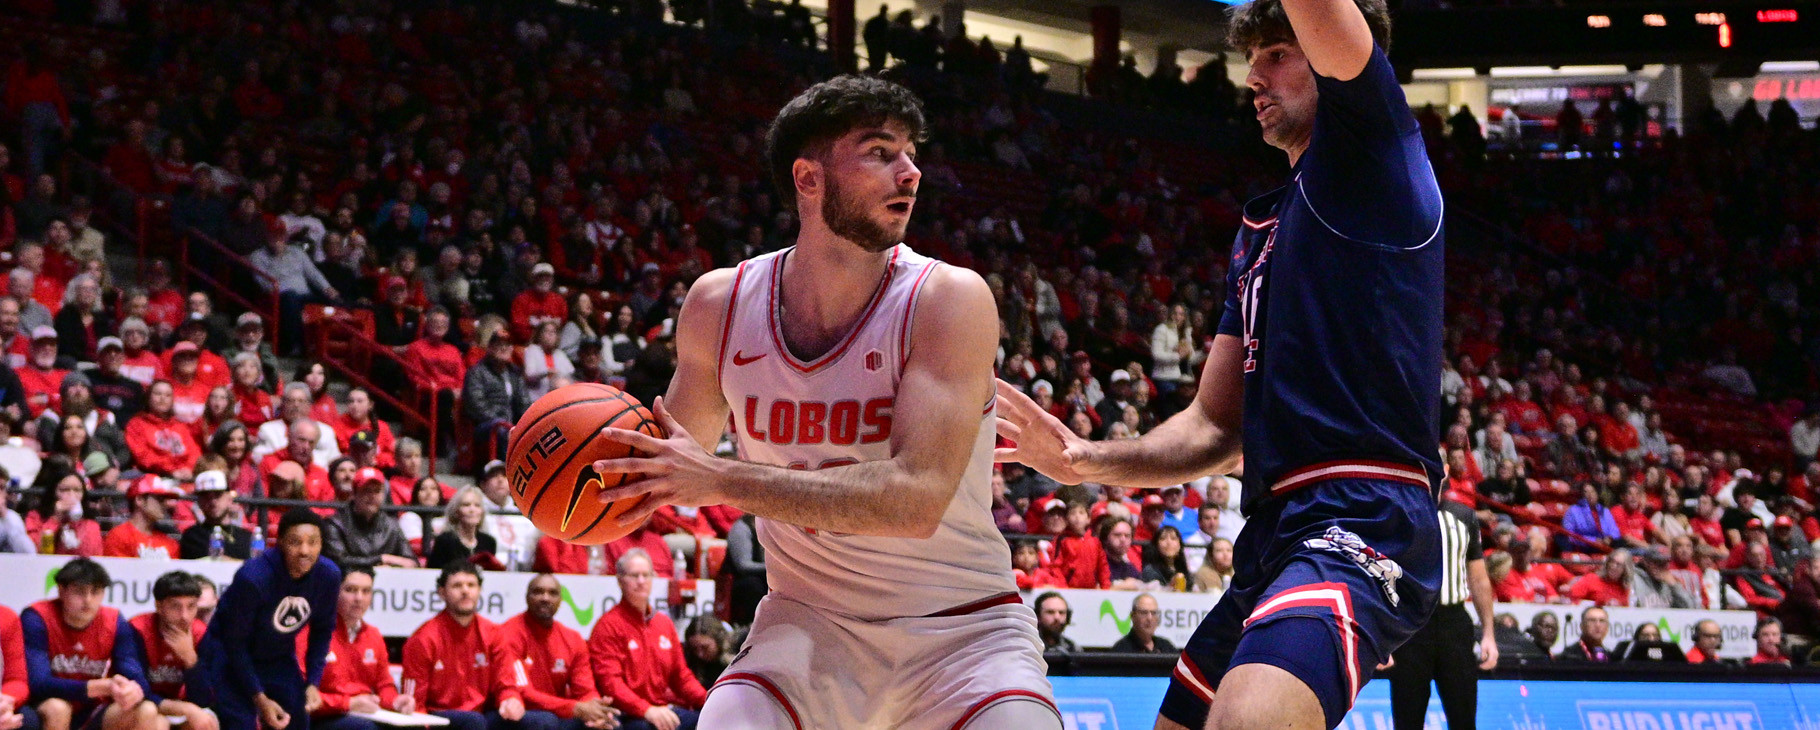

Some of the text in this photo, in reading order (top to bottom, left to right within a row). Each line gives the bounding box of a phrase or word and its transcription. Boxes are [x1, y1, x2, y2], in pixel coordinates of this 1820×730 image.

[744, 394, 895, 445] LOBOS
[512, 426, 568, 498] ELITE
[371, 588, 505, 614] NUSEA
